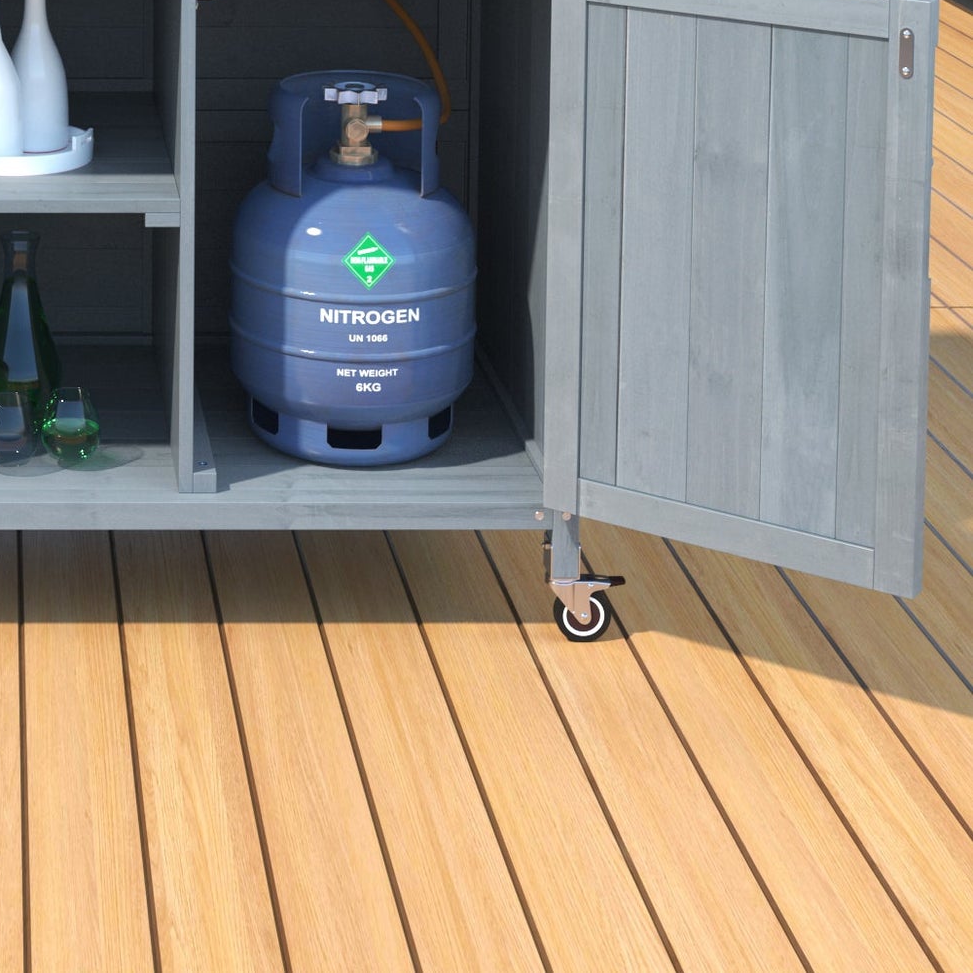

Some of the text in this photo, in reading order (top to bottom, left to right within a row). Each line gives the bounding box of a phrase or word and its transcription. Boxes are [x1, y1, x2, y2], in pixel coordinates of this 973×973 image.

[319, 307, 420, 325] NITROGEN
[348, 334, 364, 342] UN
[336, 368, 399, 378] NET WEIGHT
[355, 382, 381, 392] 6KG
